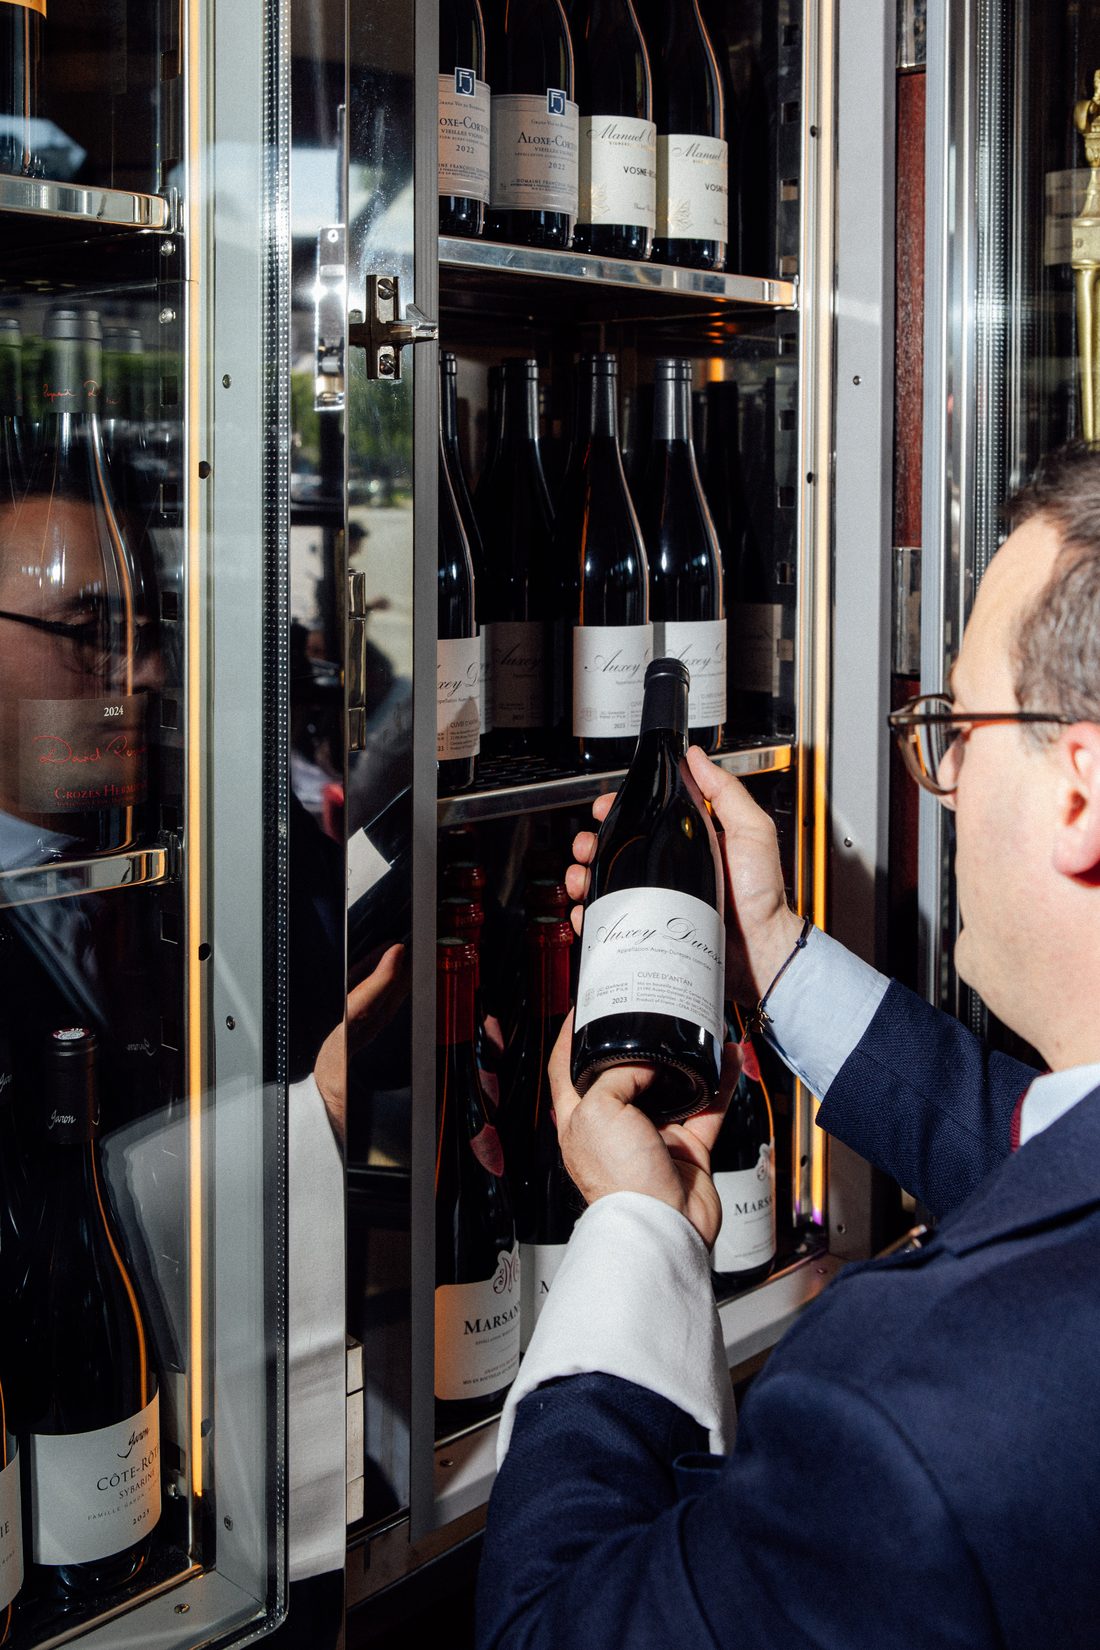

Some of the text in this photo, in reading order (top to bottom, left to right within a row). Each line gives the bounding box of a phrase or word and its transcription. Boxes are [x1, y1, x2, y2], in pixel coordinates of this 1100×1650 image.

[586, 123, 647, 142] Manuel
[455, 144, 475, 155] 2022
[547, 161, 567, 172] 2022
[584, 649, 642, 678] Auxey
[103, 704, 124, 717] 2024
[54, 786, 101, 801] CROZES
[587, 912, 658, 952] Auxey
[637, 971, 661, 979] CUVÉE
[611, 996, 628, 1005] 2023
[463, 1302, 520, 1336] MARSAN
[87, 1506, 121, 1521] FAMILLE
